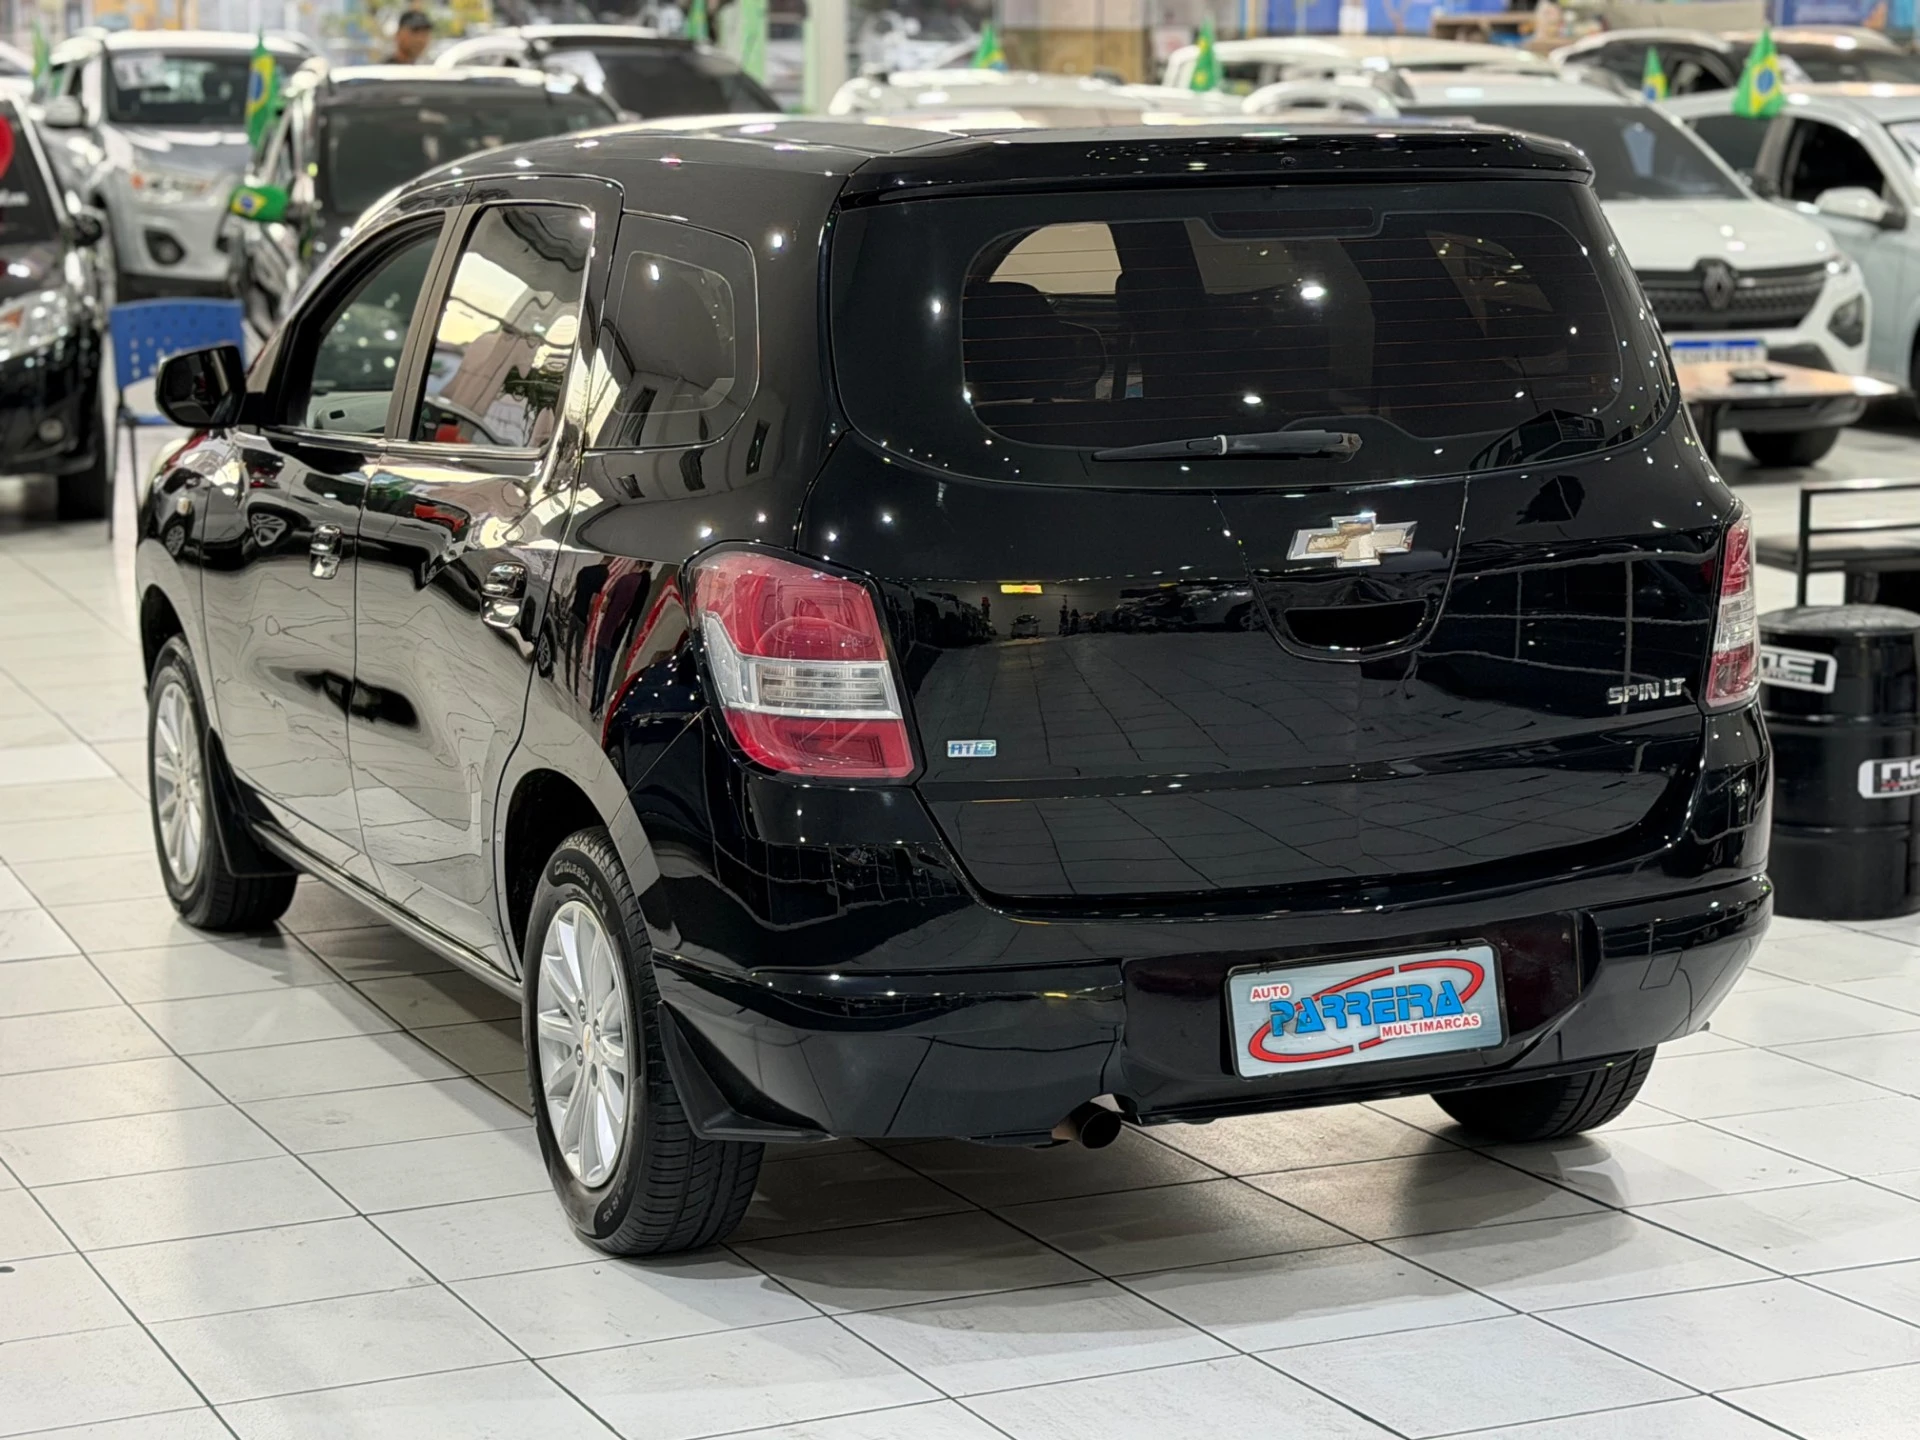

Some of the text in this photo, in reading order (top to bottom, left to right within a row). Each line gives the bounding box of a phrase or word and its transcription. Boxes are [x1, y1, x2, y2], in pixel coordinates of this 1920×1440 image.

[1608, 678, 1686, 704] SPIN LT
[1252, 985, 1290, 1000] AUTO
[1269, 980, 1464, 1037] PARREIRA
[1381, 1015, 1480, 1037] MULTIMARCAS
